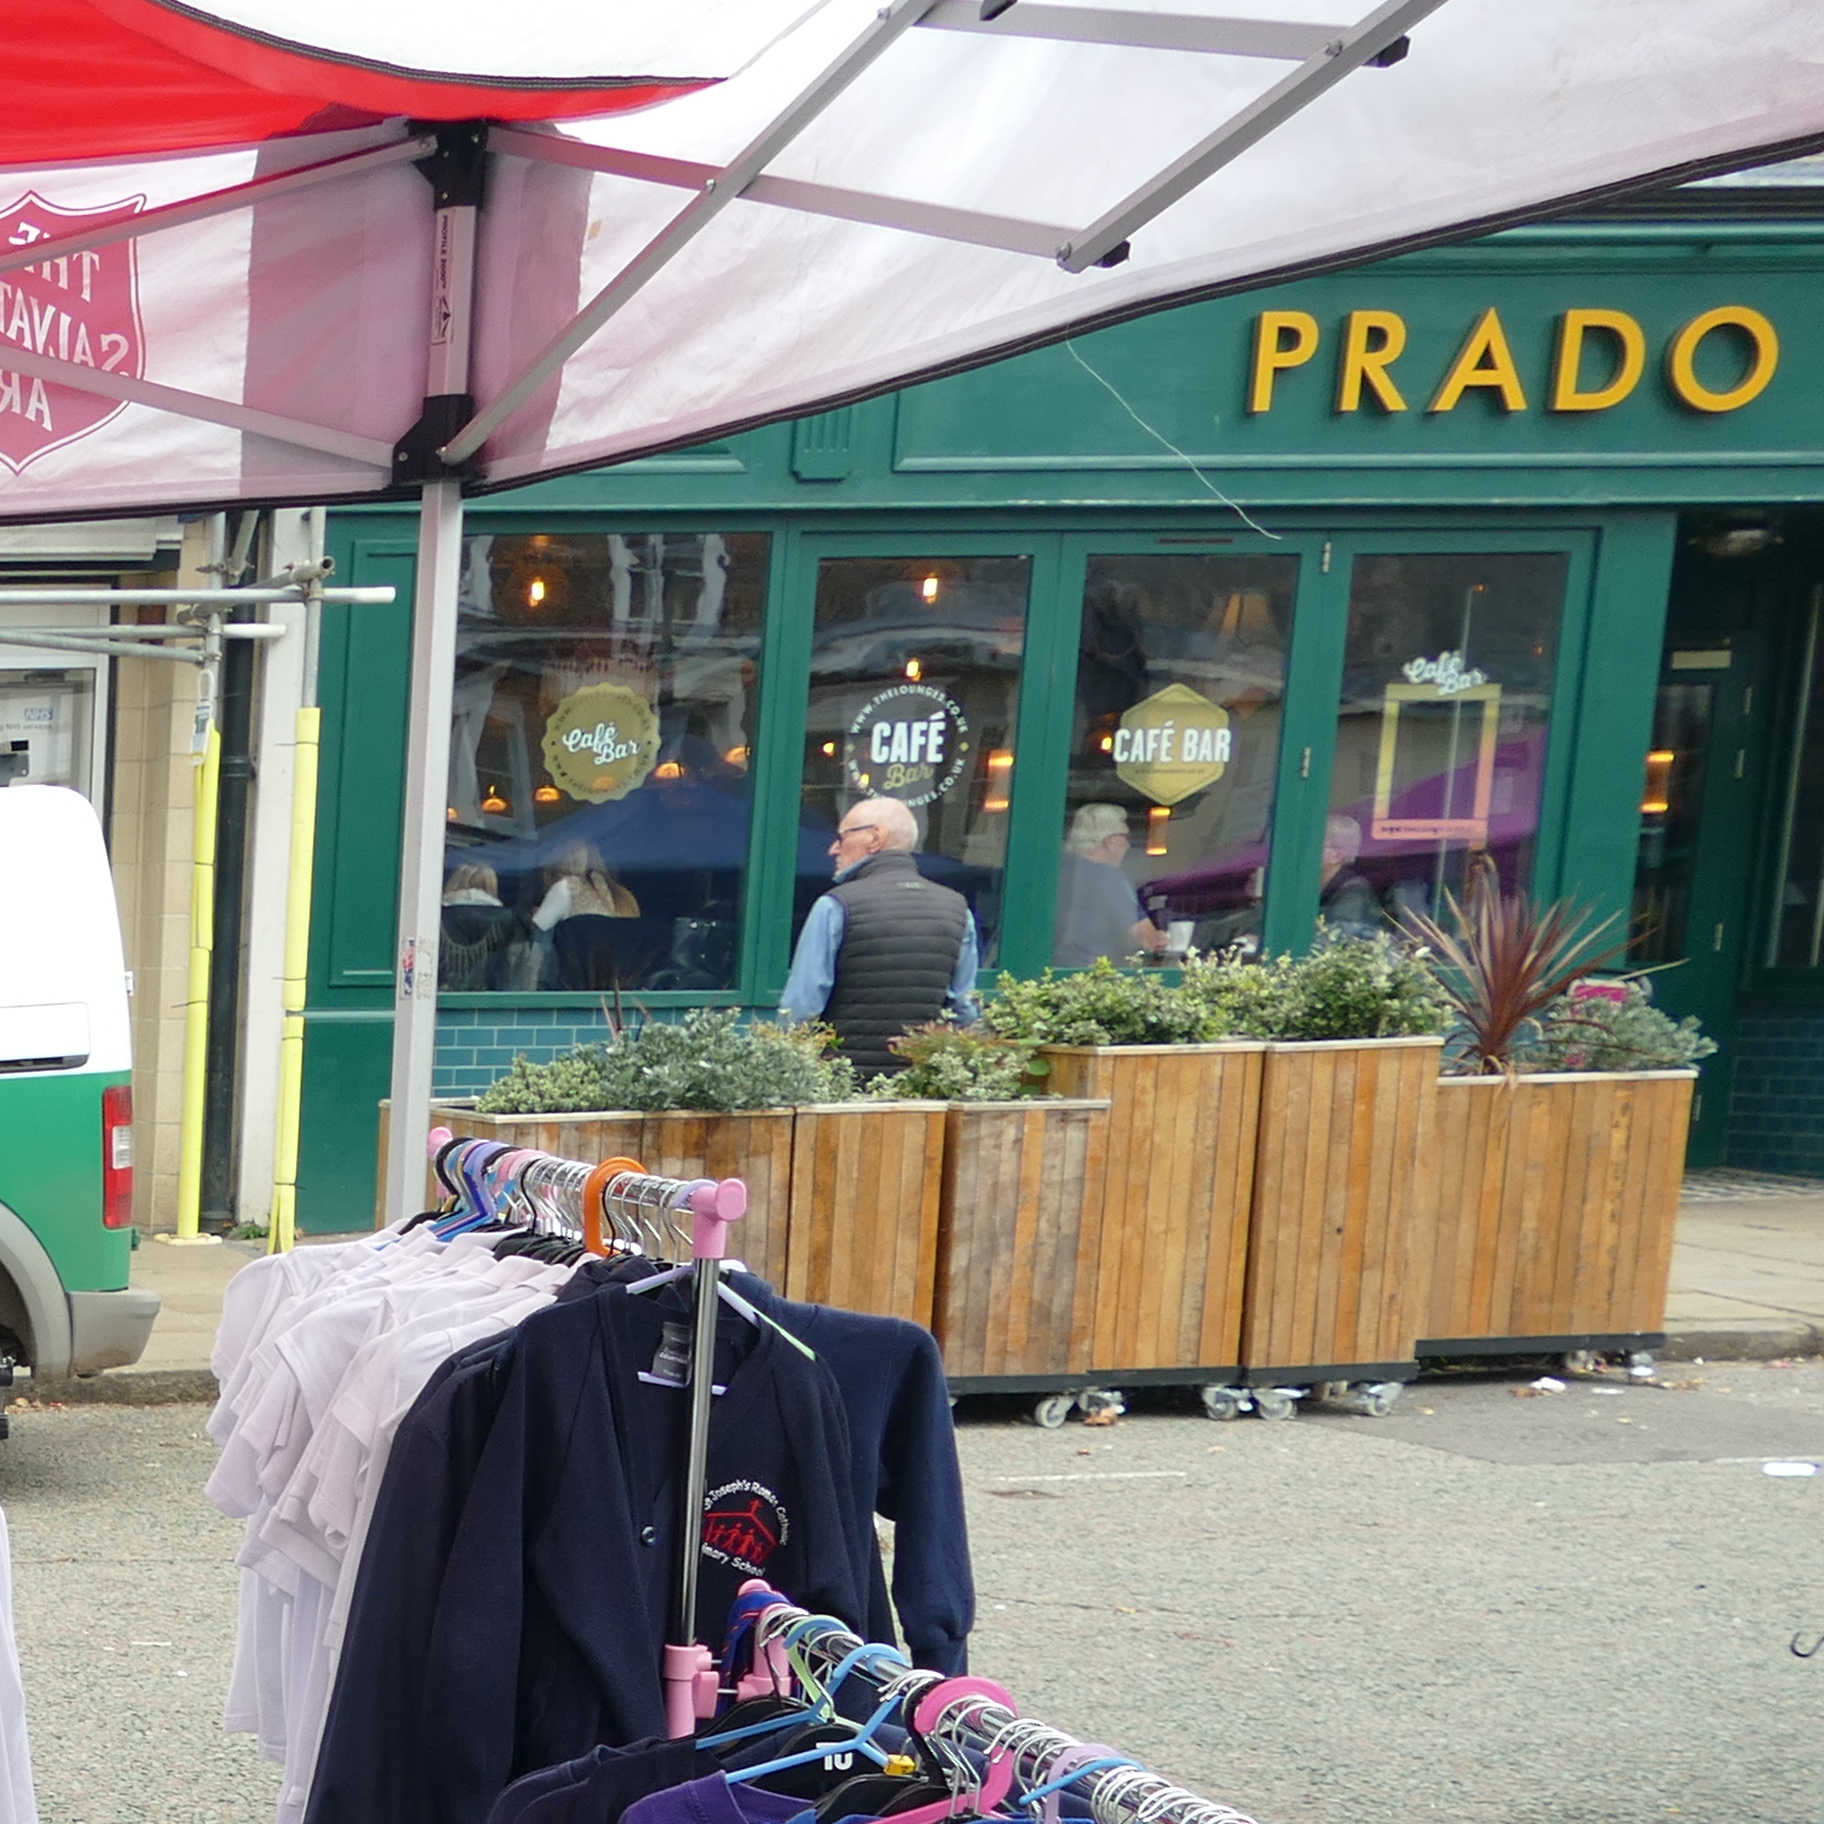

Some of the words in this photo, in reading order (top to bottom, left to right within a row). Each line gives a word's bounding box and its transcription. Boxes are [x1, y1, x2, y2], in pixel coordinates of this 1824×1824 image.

[1249, 304, 1781, 413] PRADO
[24, 708, 53, 721] NHS
[562, 721, 618, 754] Café
[594, 739, 641, 765] Bar
[871, 710, 947, 764] CAFÉ
[1113, 720, 1175, 763] CAFÉ
[1182, 728, 1232, 763] BAR
[883, 762, 935, 790] Bar
[702, 1542, 730, 1566] imary
